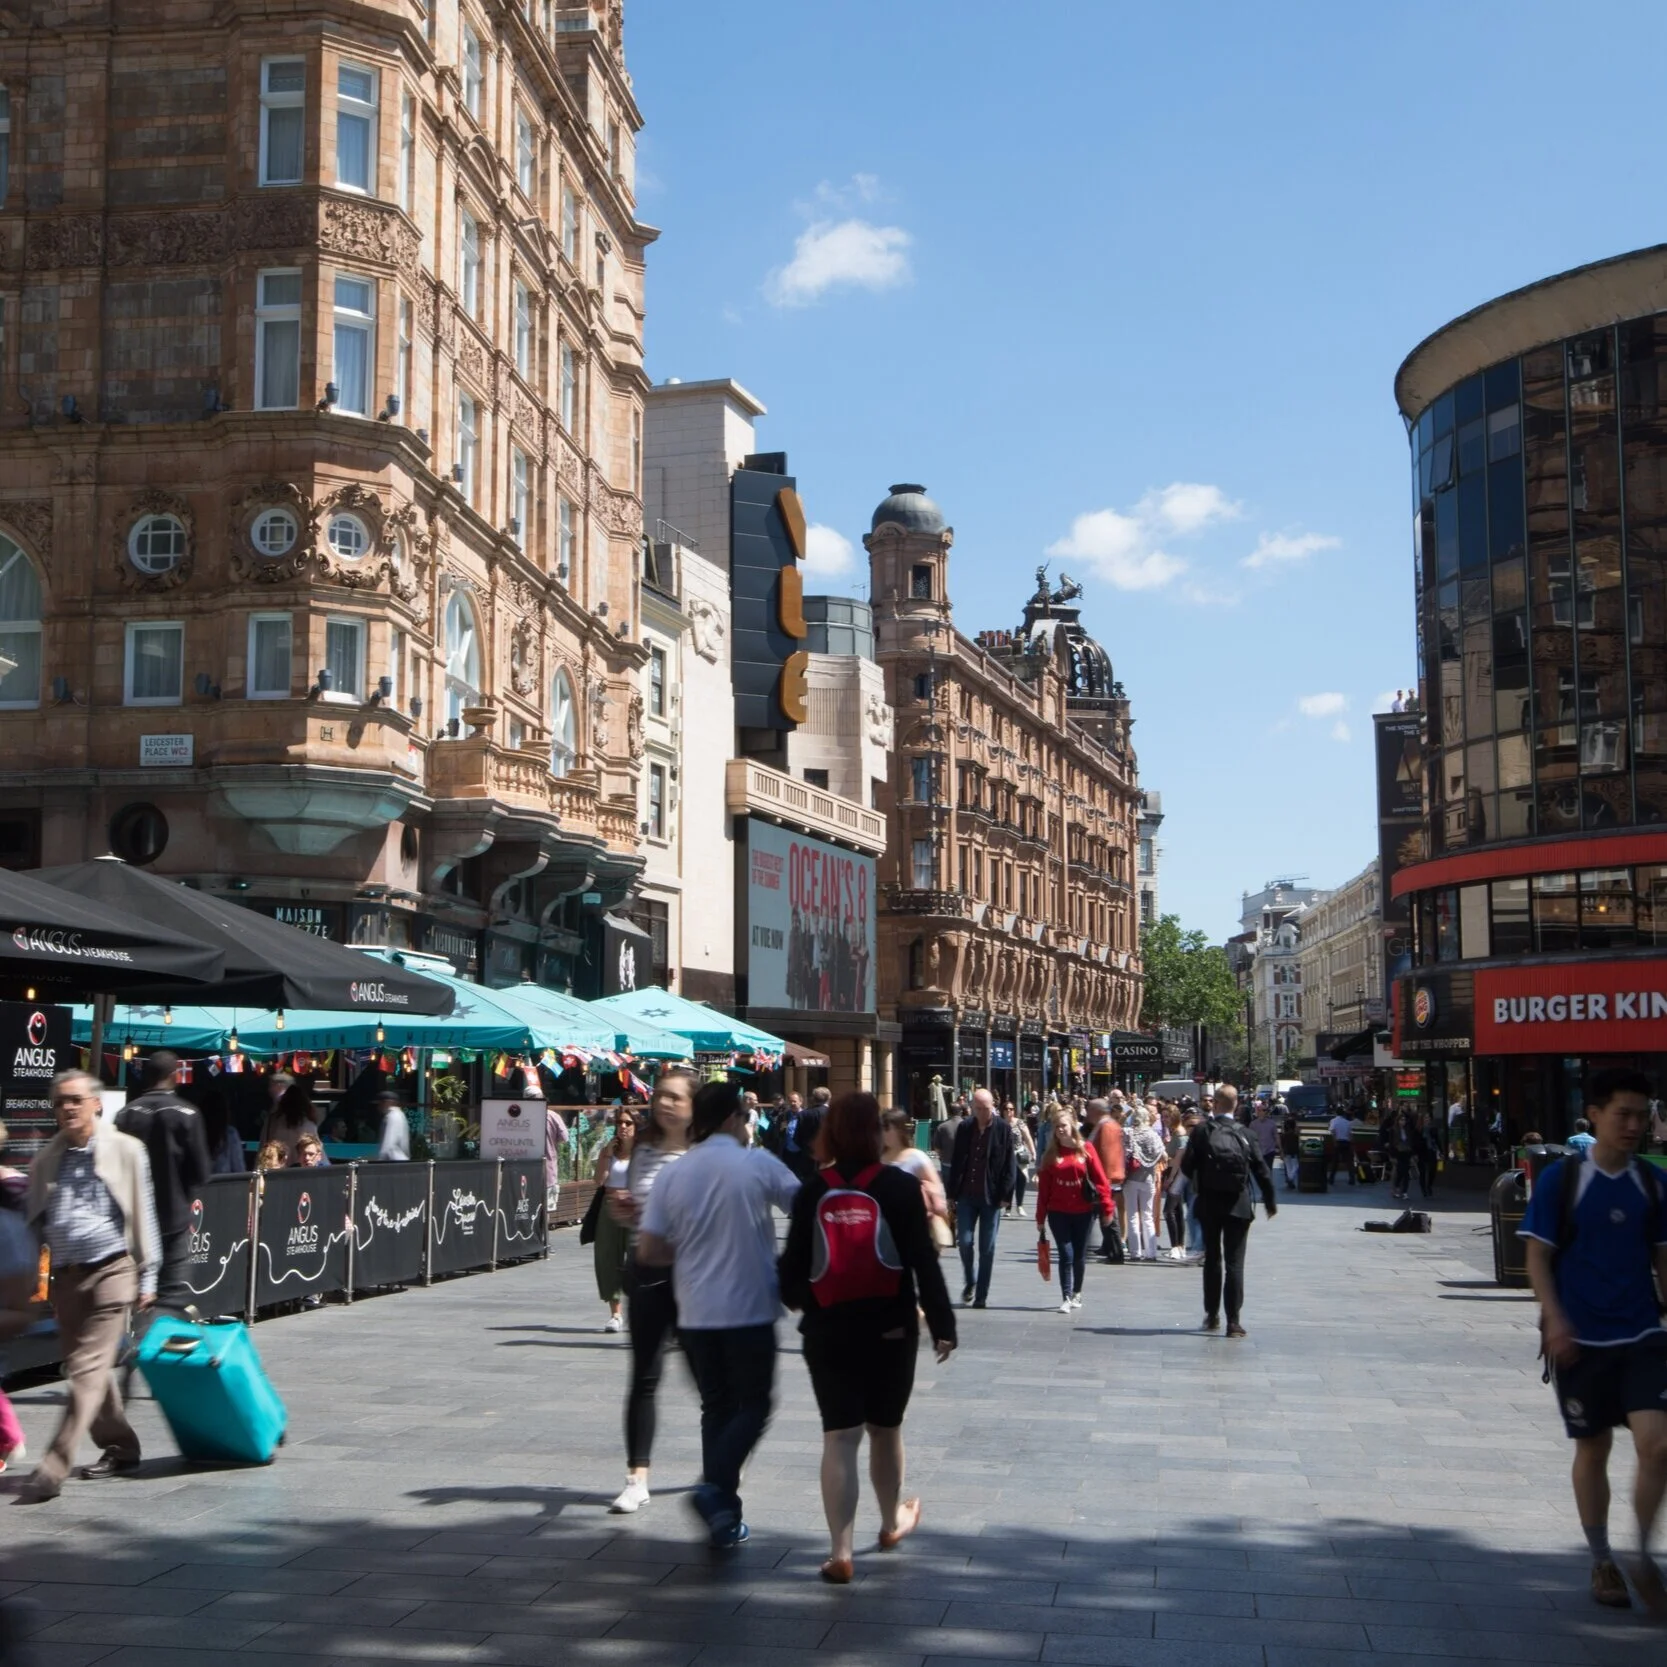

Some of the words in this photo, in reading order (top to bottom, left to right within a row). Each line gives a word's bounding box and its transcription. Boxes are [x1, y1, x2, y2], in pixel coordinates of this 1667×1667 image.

[145, 738, 184, 747] LEICESTER
[145, 747, 168, 756] PLACE
[171, 747, 188, 755] WC2
[789, 842, 854, 925] OCEAN'S
[858, 864, 867, 923] 8
[276, 907, 322, 923] MAISON
[30, 928, 82, 956] ANGUS
[81, 947, 134, 962] STEAKHOUSE
[359, 982, 385, 1002] ANGUS
[1494, 994, 1608, 1024] BURGER
[1615, 991, 1667, 1020] KIN
[271, 1032, 346, 1049] MAISON
[1433, 1038, 1470, 1049] WHOPPER
[14, 1048, 56, 1067] ANGUS
[1115, 1046, 1158, 1056] CASINO
[13, 1068, 54, 1078] STEAKHOUSE
[6, 1099, 37, 1109] BREAKFAST
[497, 1119, 530, 1128] ANGUS
[489, 1138, 513, 1146] OPEN
[513, 1139, 536, 1147] UNTIL
[287, 1225, 318, 1245] ANGUS
[286, 1243, 317, 1256] STEAKHOUSE
